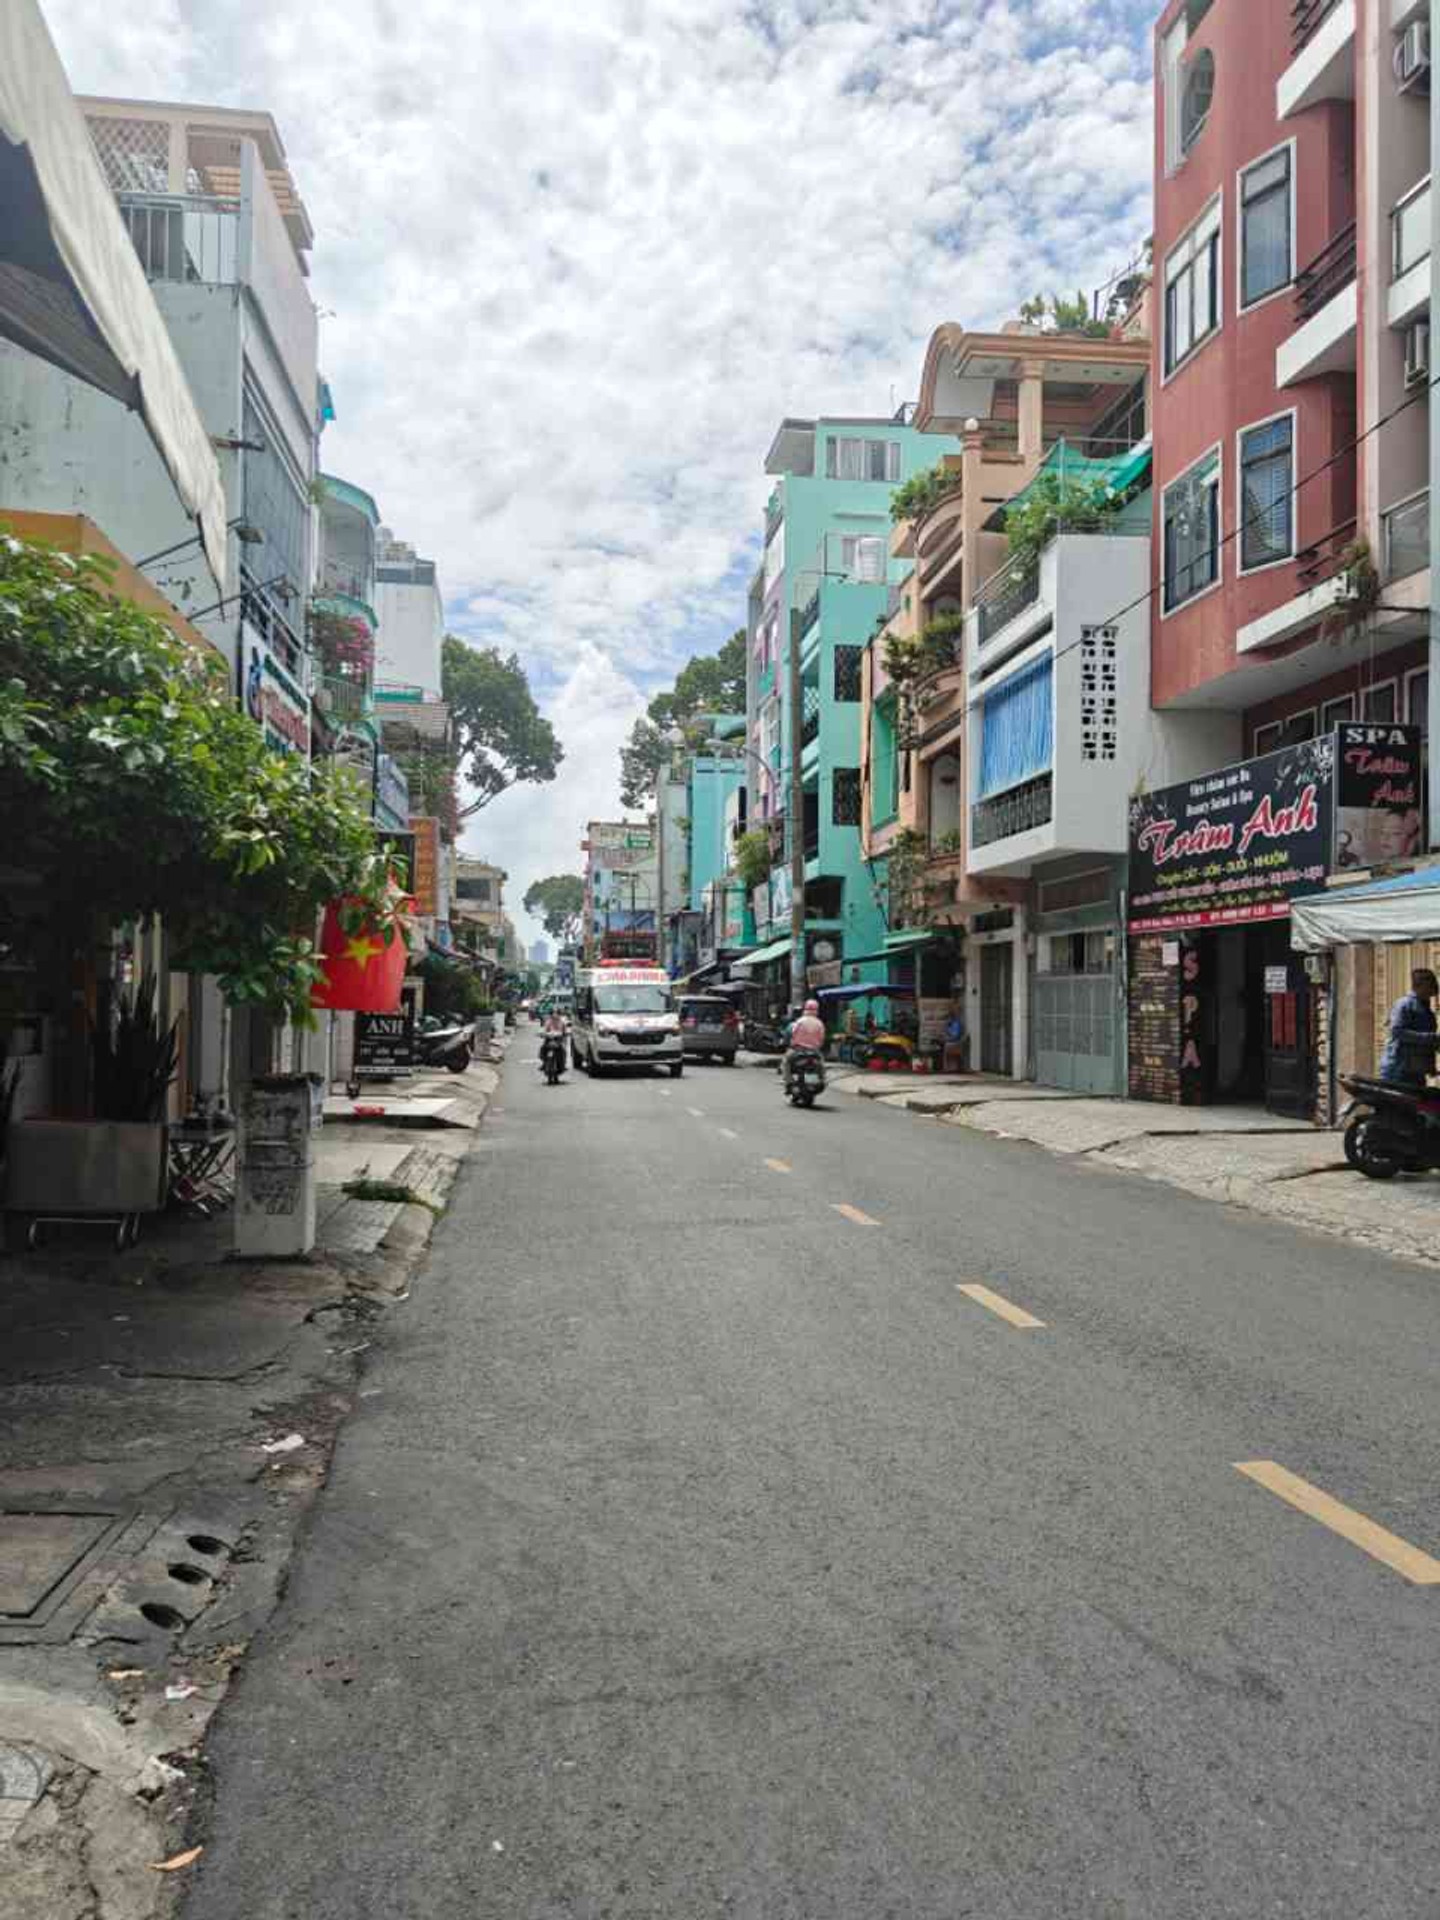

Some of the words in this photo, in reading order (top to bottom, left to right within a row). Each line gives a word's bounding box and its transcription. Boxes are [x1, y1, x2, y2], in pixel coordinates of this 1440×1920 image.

[1345, 727, 1408, 745] SPA
[1370, 779, 1415, 807] Anh
[1138, 819, 1234, 865] Trâm
[1237, 784, 1318, 854] Anh
[366, 1019, 404, 1033] ANH
